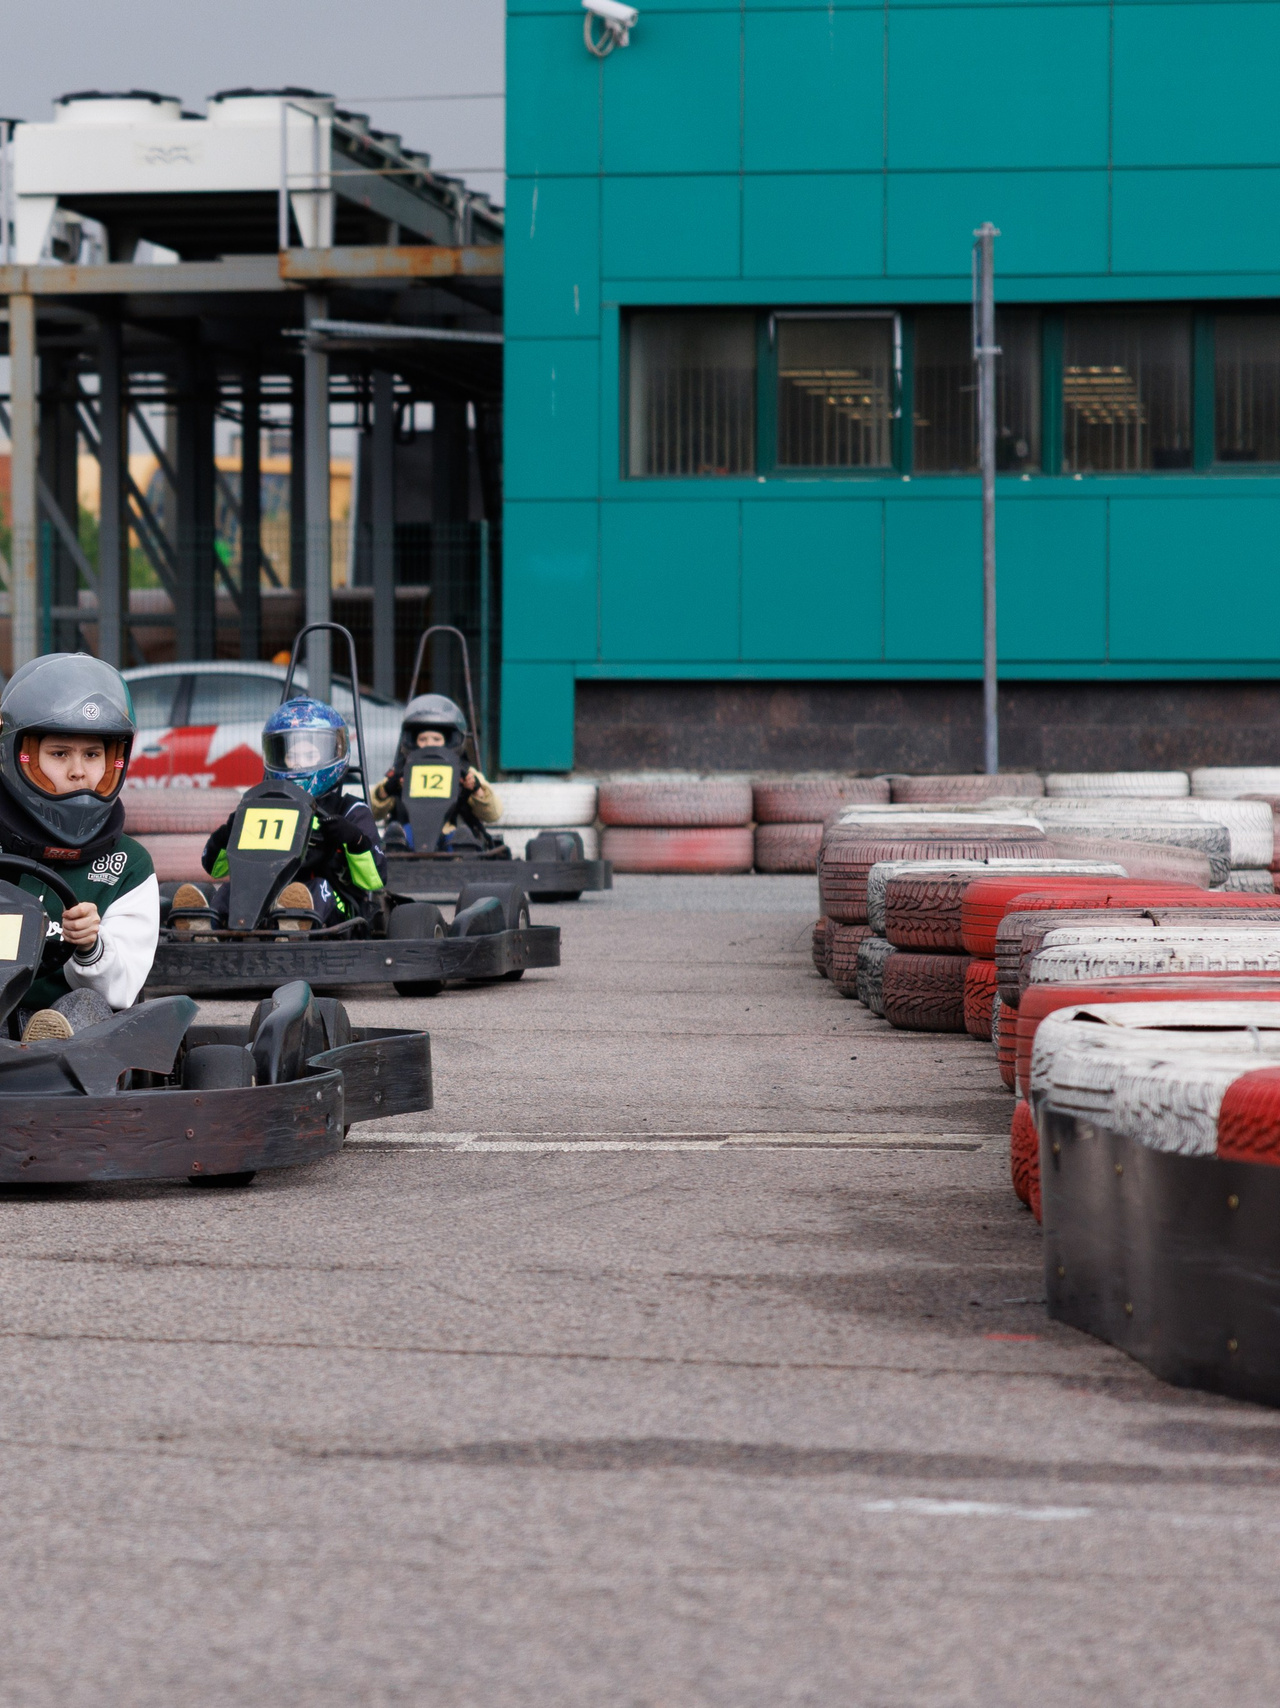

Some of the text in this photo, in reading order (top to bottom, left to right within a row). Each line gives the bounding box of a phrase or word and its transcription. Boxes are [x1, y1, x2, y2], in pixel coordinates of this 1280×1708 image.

[421, 774, 444, 789] 12
[257, 819, 284, 840] 11
[92, 852, 127, 875] 88
